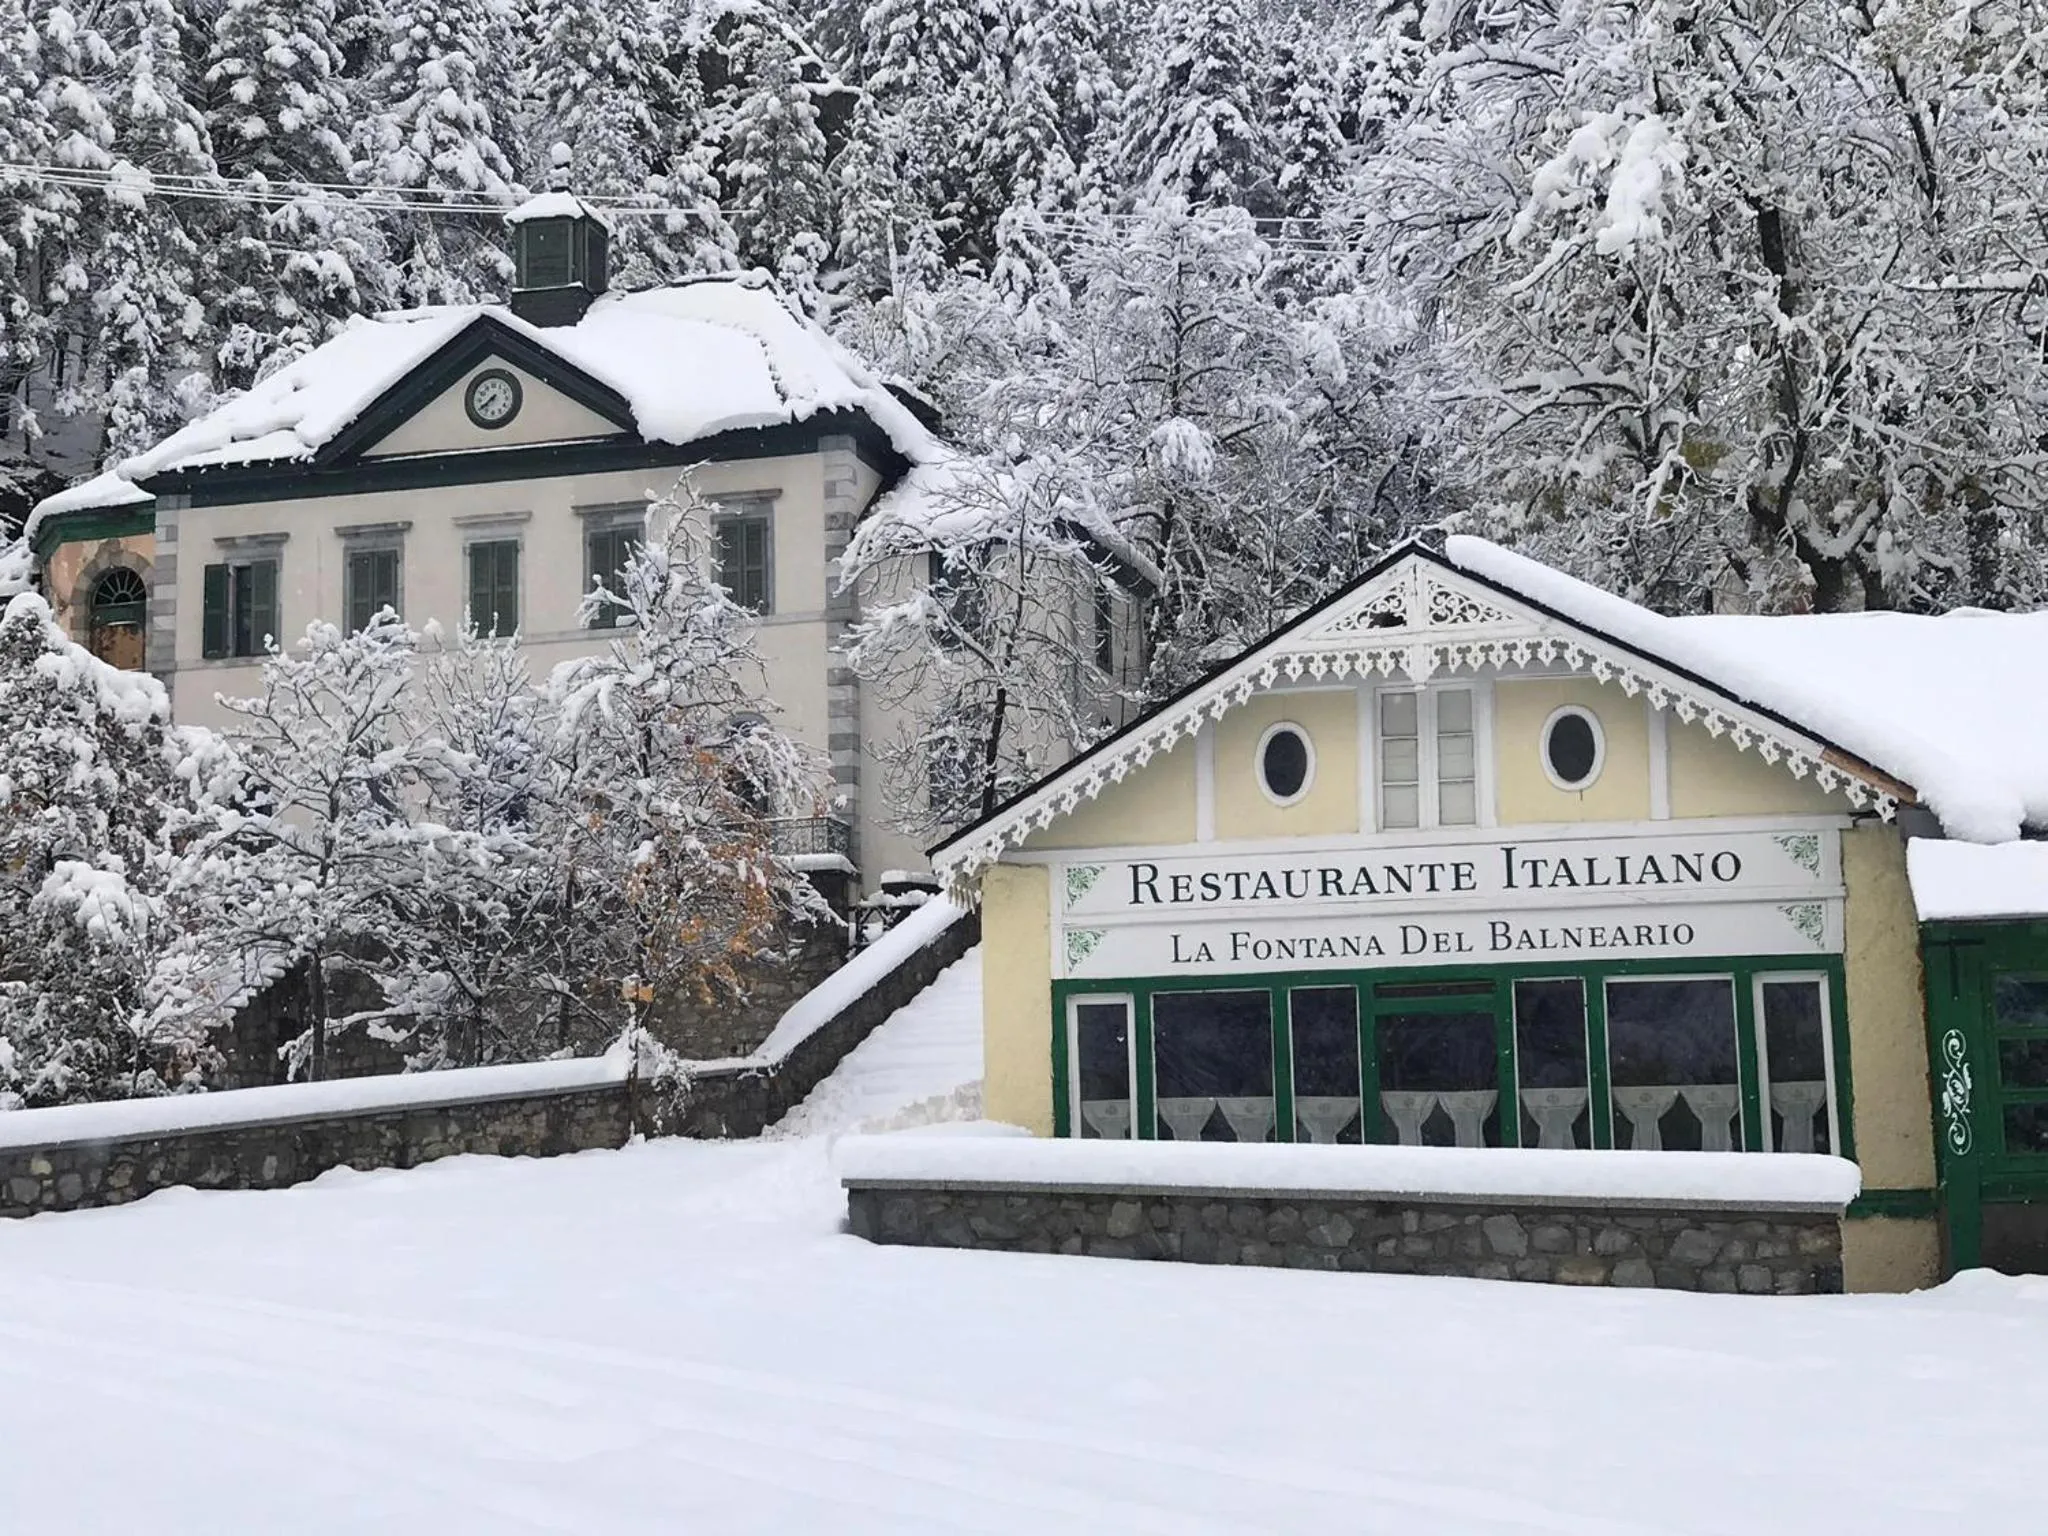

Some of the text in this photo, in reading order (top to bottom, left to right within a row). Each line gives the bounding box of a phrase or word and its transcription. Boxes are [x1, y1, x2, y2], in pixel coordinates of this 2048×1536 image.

[1127, 846, 1742, 905] RESTAURANTE ITALIANO
[1170, 921, 1694, 963] LA FONTANA DEL BALNEARIO
